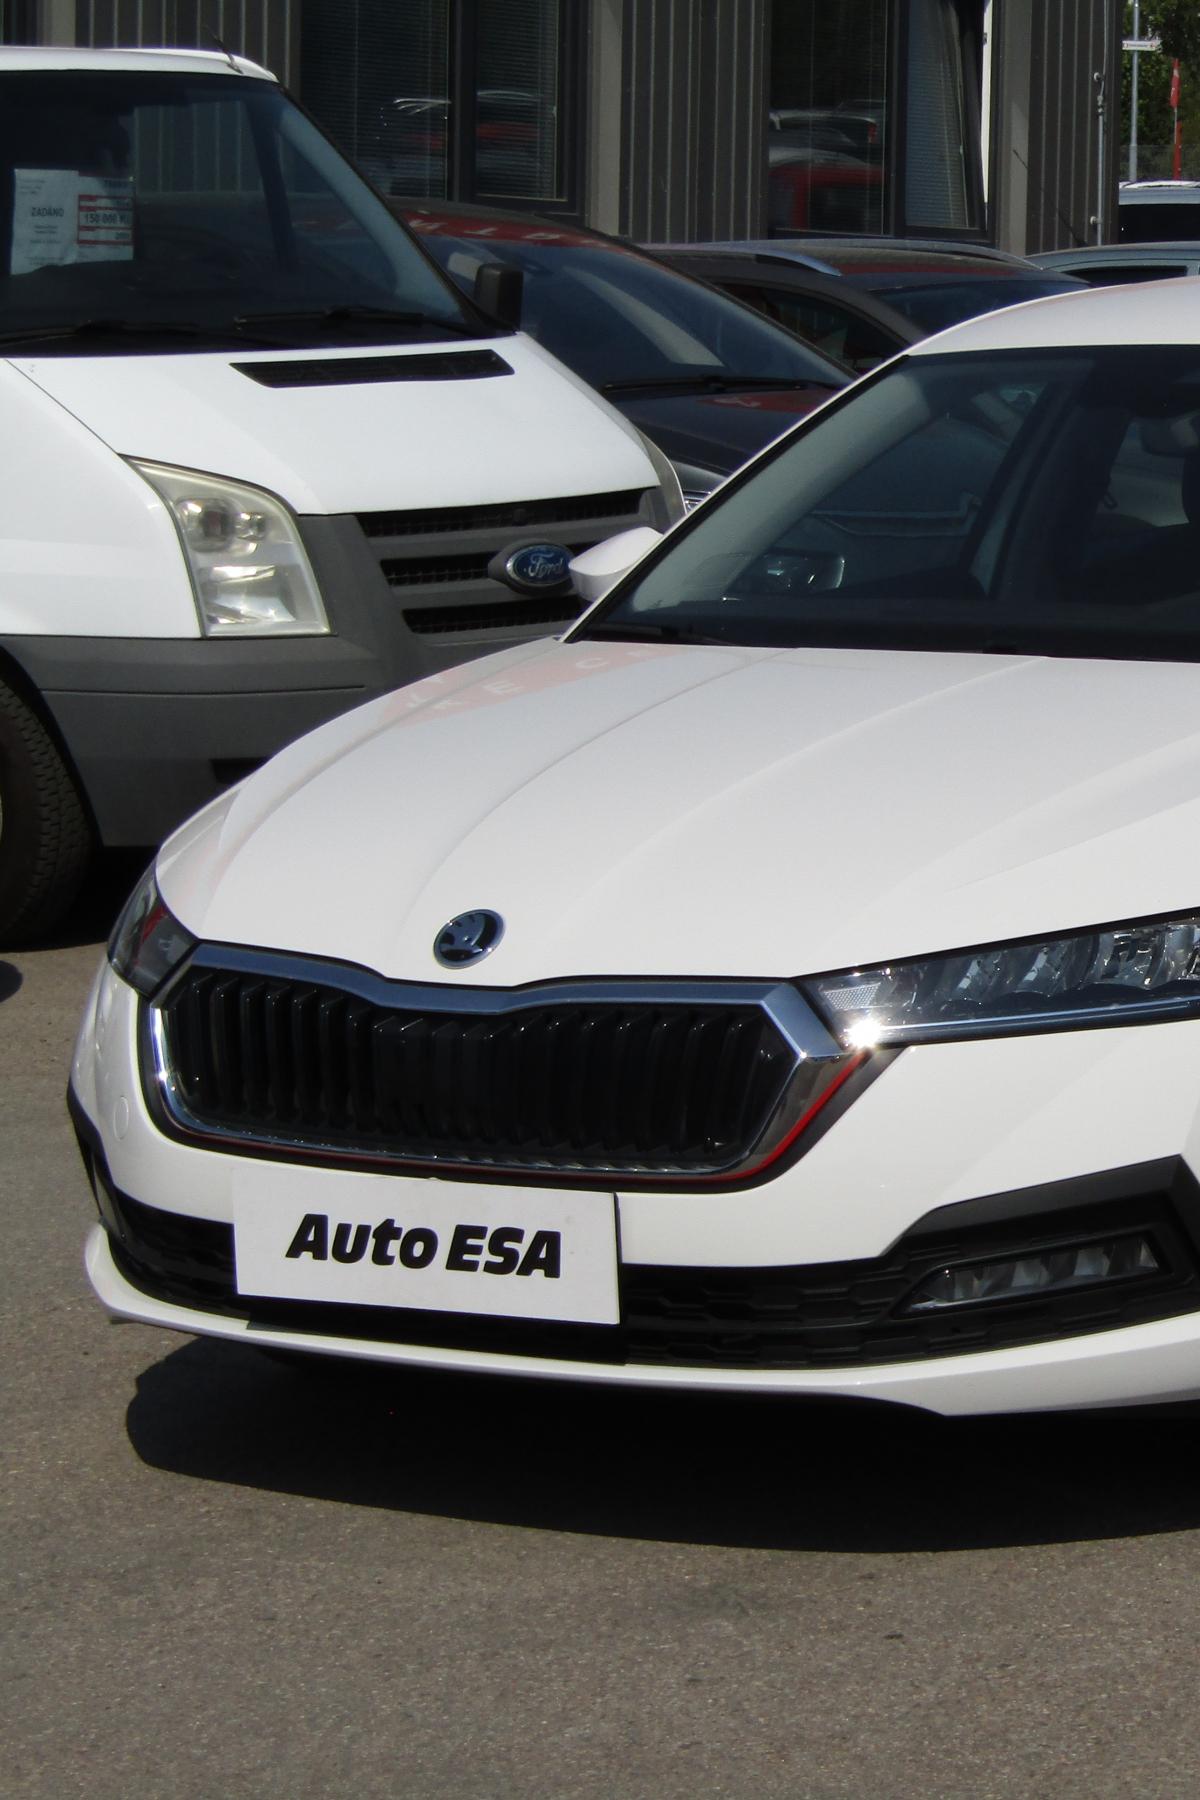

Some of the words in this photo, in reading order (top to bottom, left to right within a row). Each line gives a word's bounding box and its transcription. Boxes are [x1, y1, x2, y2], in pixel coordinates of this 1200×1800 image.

[528, 553, 563, 577] Ford
[285, 1213, 438, 1269] Auto
[445, 1224, 561, 1279] ESA
